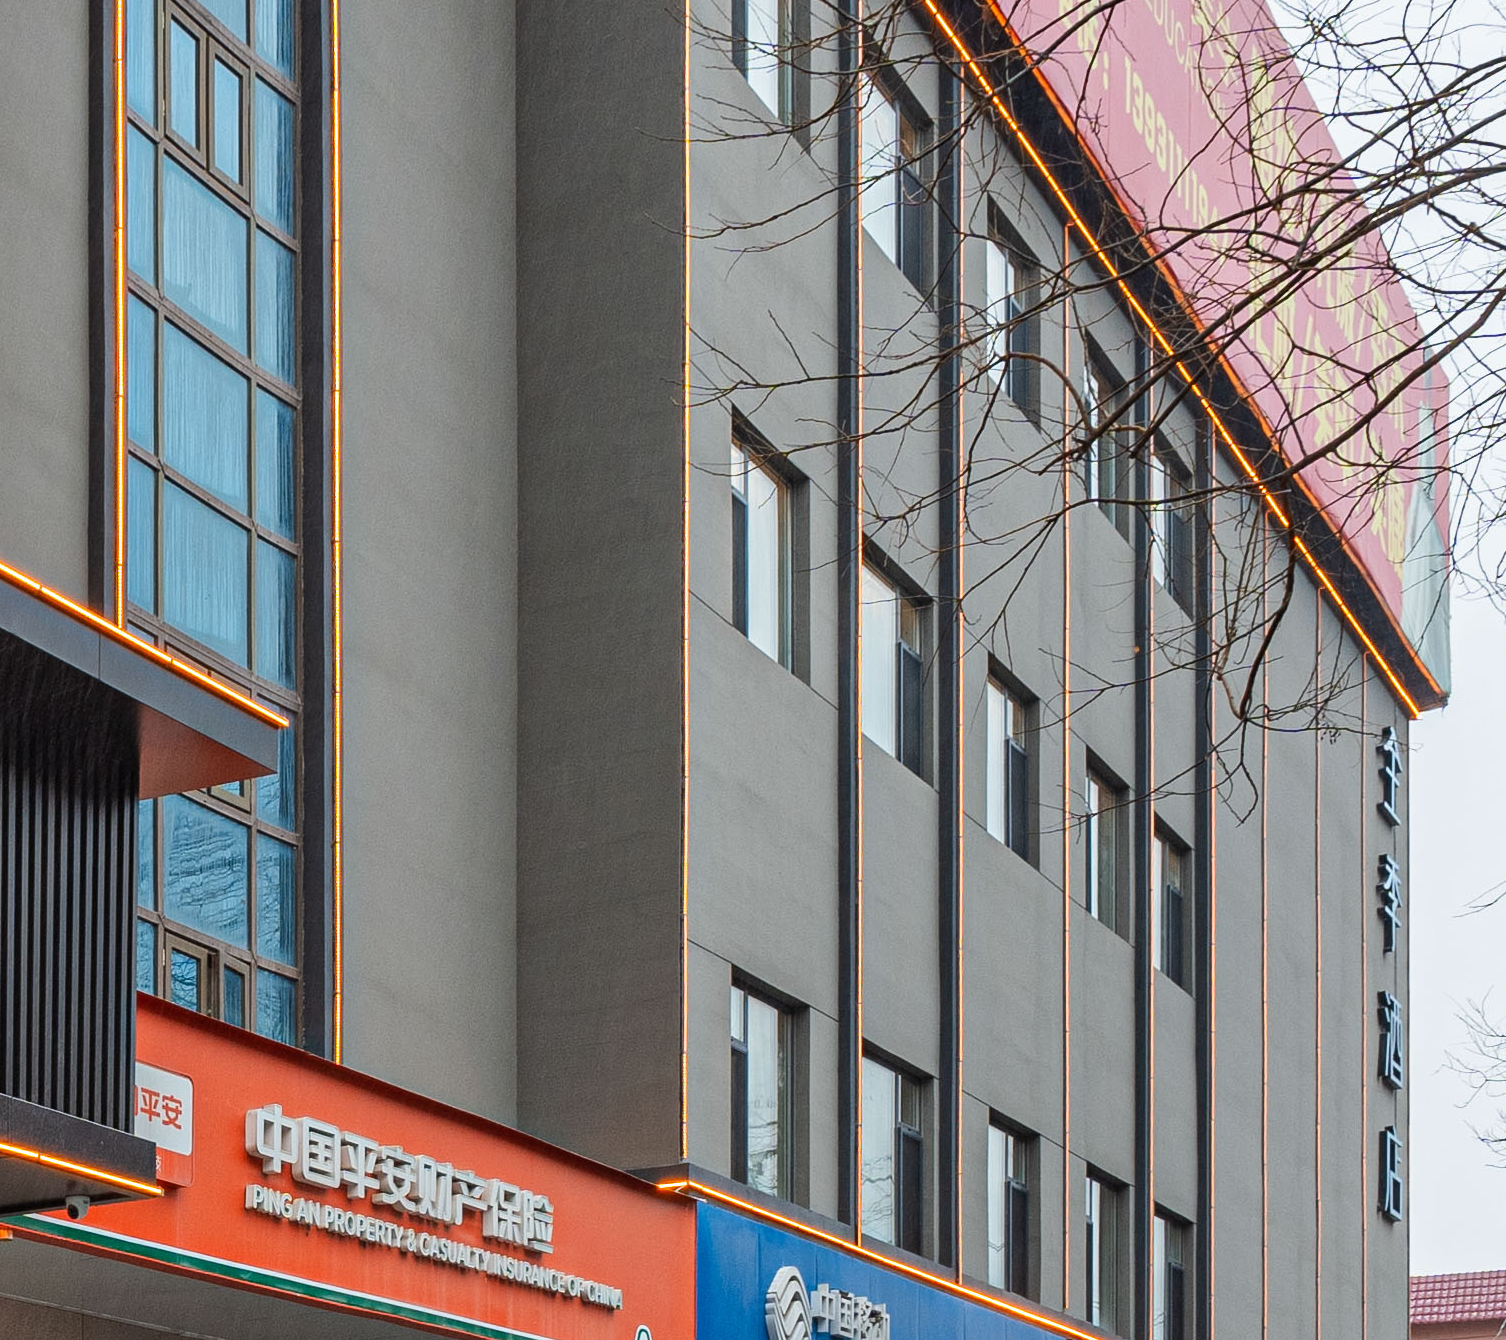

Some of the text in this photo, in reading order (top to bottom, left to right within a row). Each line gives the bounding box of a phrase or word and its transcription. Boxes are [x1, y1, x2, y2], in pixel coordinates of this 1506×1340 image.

[1376, 725, 1403, 1222] 全季酒店
[244, 1103, 555, 1254] 中国平安财产保险
[246, 1184, 624, 1311] PING AN PROPERTY & CASUALTY INSURANCE OF CHINA
